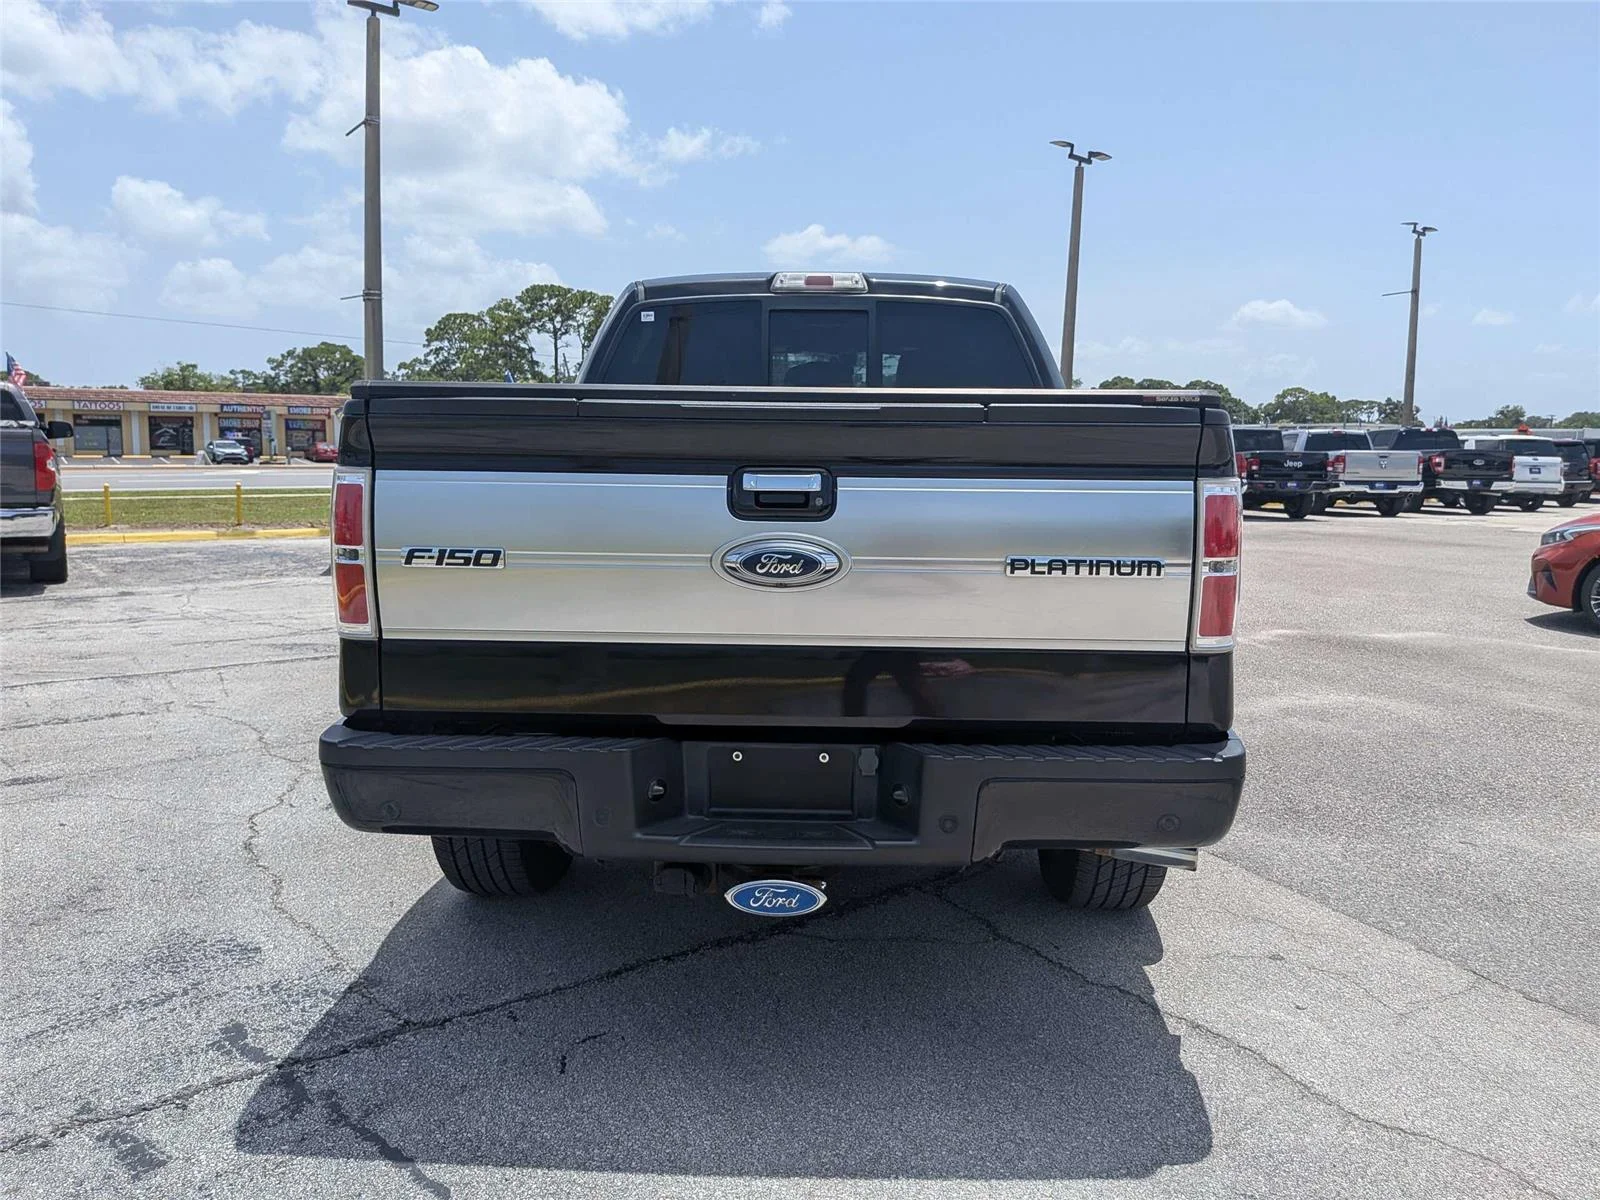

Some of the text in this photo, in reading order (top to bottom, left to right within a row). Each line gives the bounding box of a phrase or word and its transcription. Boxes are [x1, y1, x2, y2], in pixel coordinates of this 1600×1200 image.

[75, 400, 122, 410] TATTOOS
[223, 405, 264, 413] AUTHENTIC
[312, 407, 329, 415] SHOP
[1283, 459, 1303, 469] Jeep
[404, 548, 502, 567] F-150
[755, 553, 803, 574] Ford
[1009, 558, 1162, 577] PLATINUM
[750, 887, 800, 908] Ford
